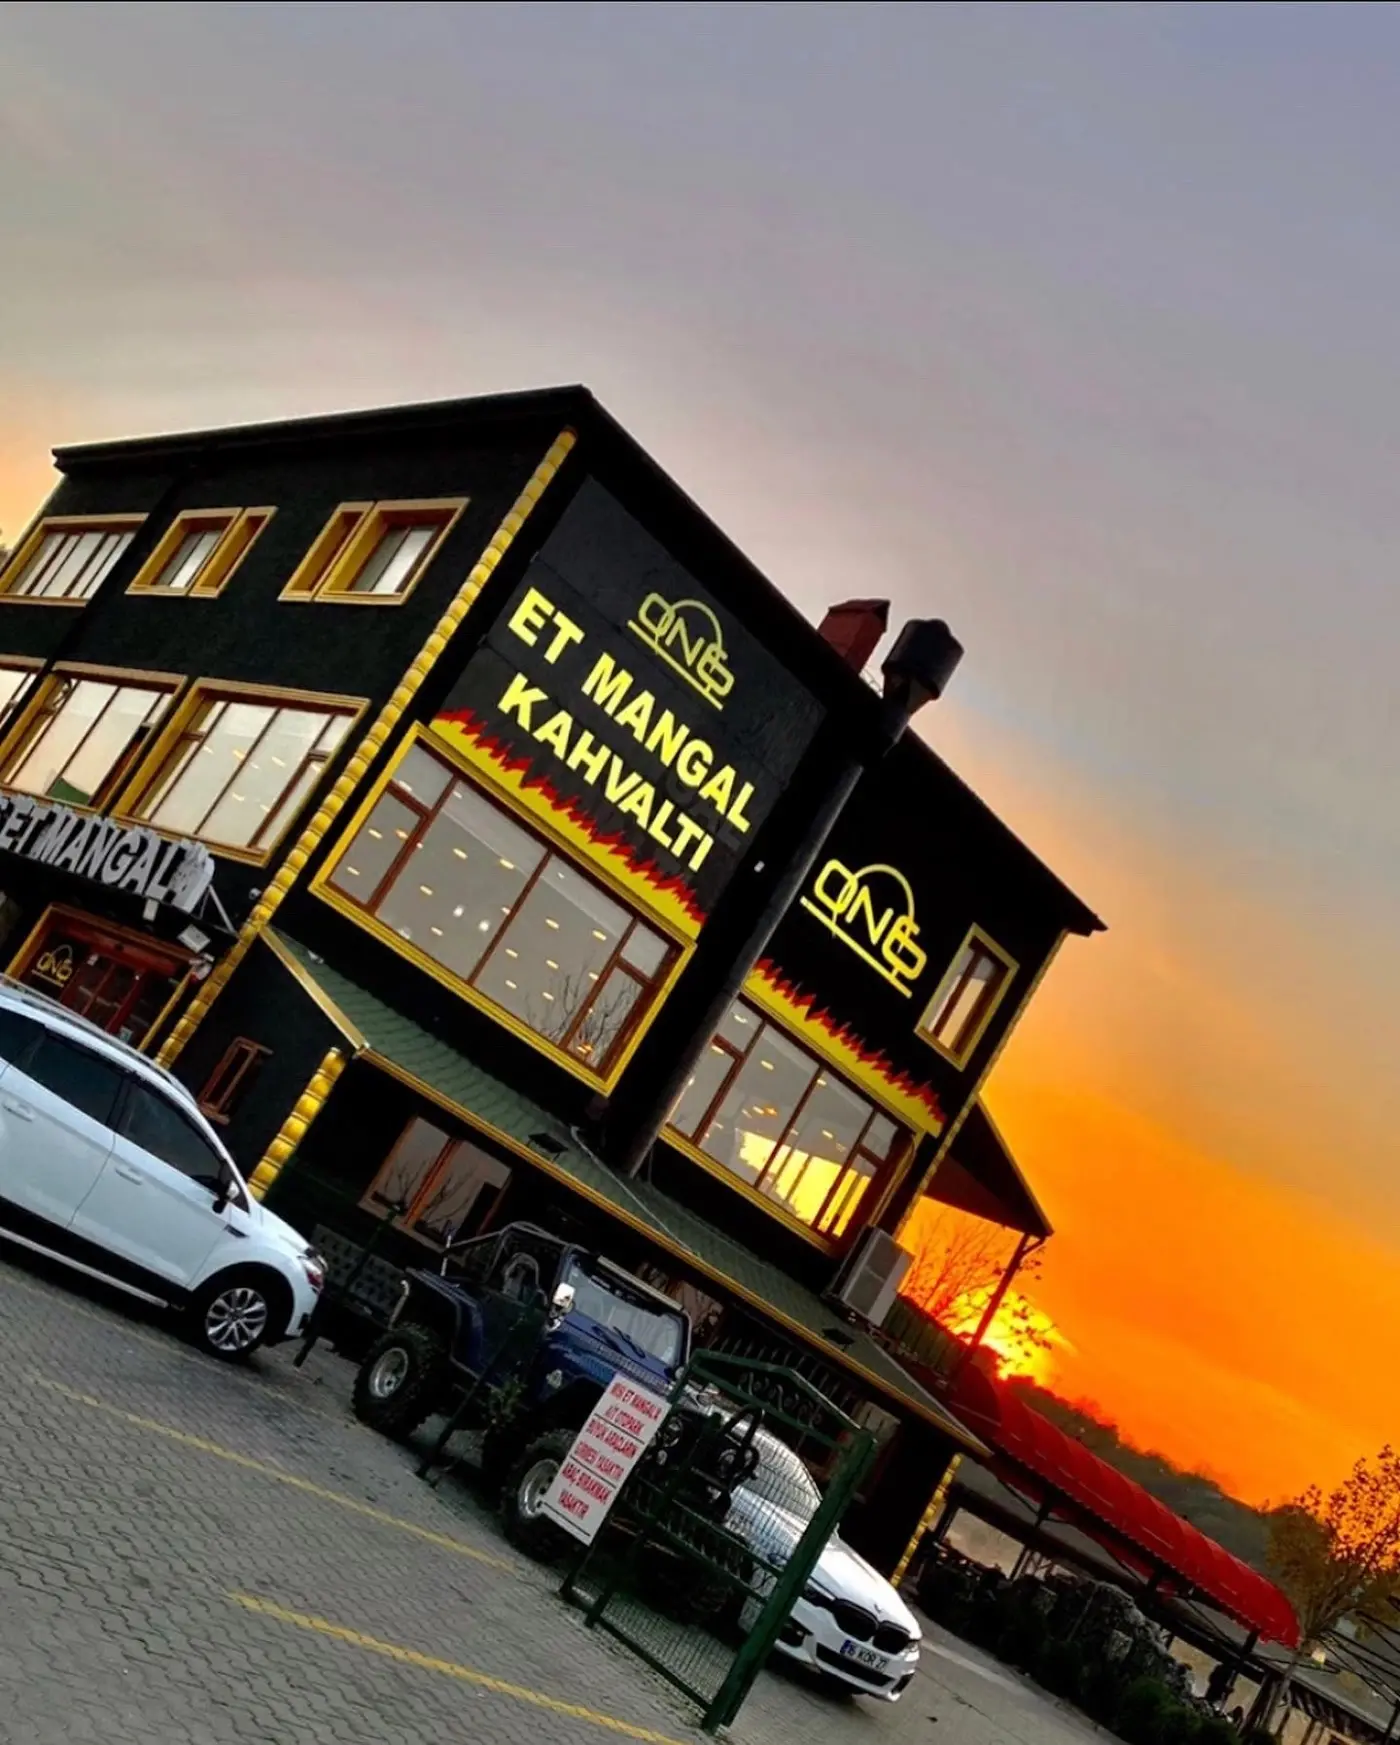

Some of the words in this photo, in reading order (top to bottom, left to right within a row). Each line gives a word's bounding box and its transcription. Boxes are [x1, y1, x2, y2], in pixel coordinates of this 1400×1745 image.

[497, 672, 714, 872] KAHVALTI
[507, 587, 585, 665] ET
[581, 652, 755, 833] MANGAL
[0, 797, 51, 853] ET
[32, 804, 180, 900] MANGAL
[558, 1489, 590, 1521] YASAKTIR
